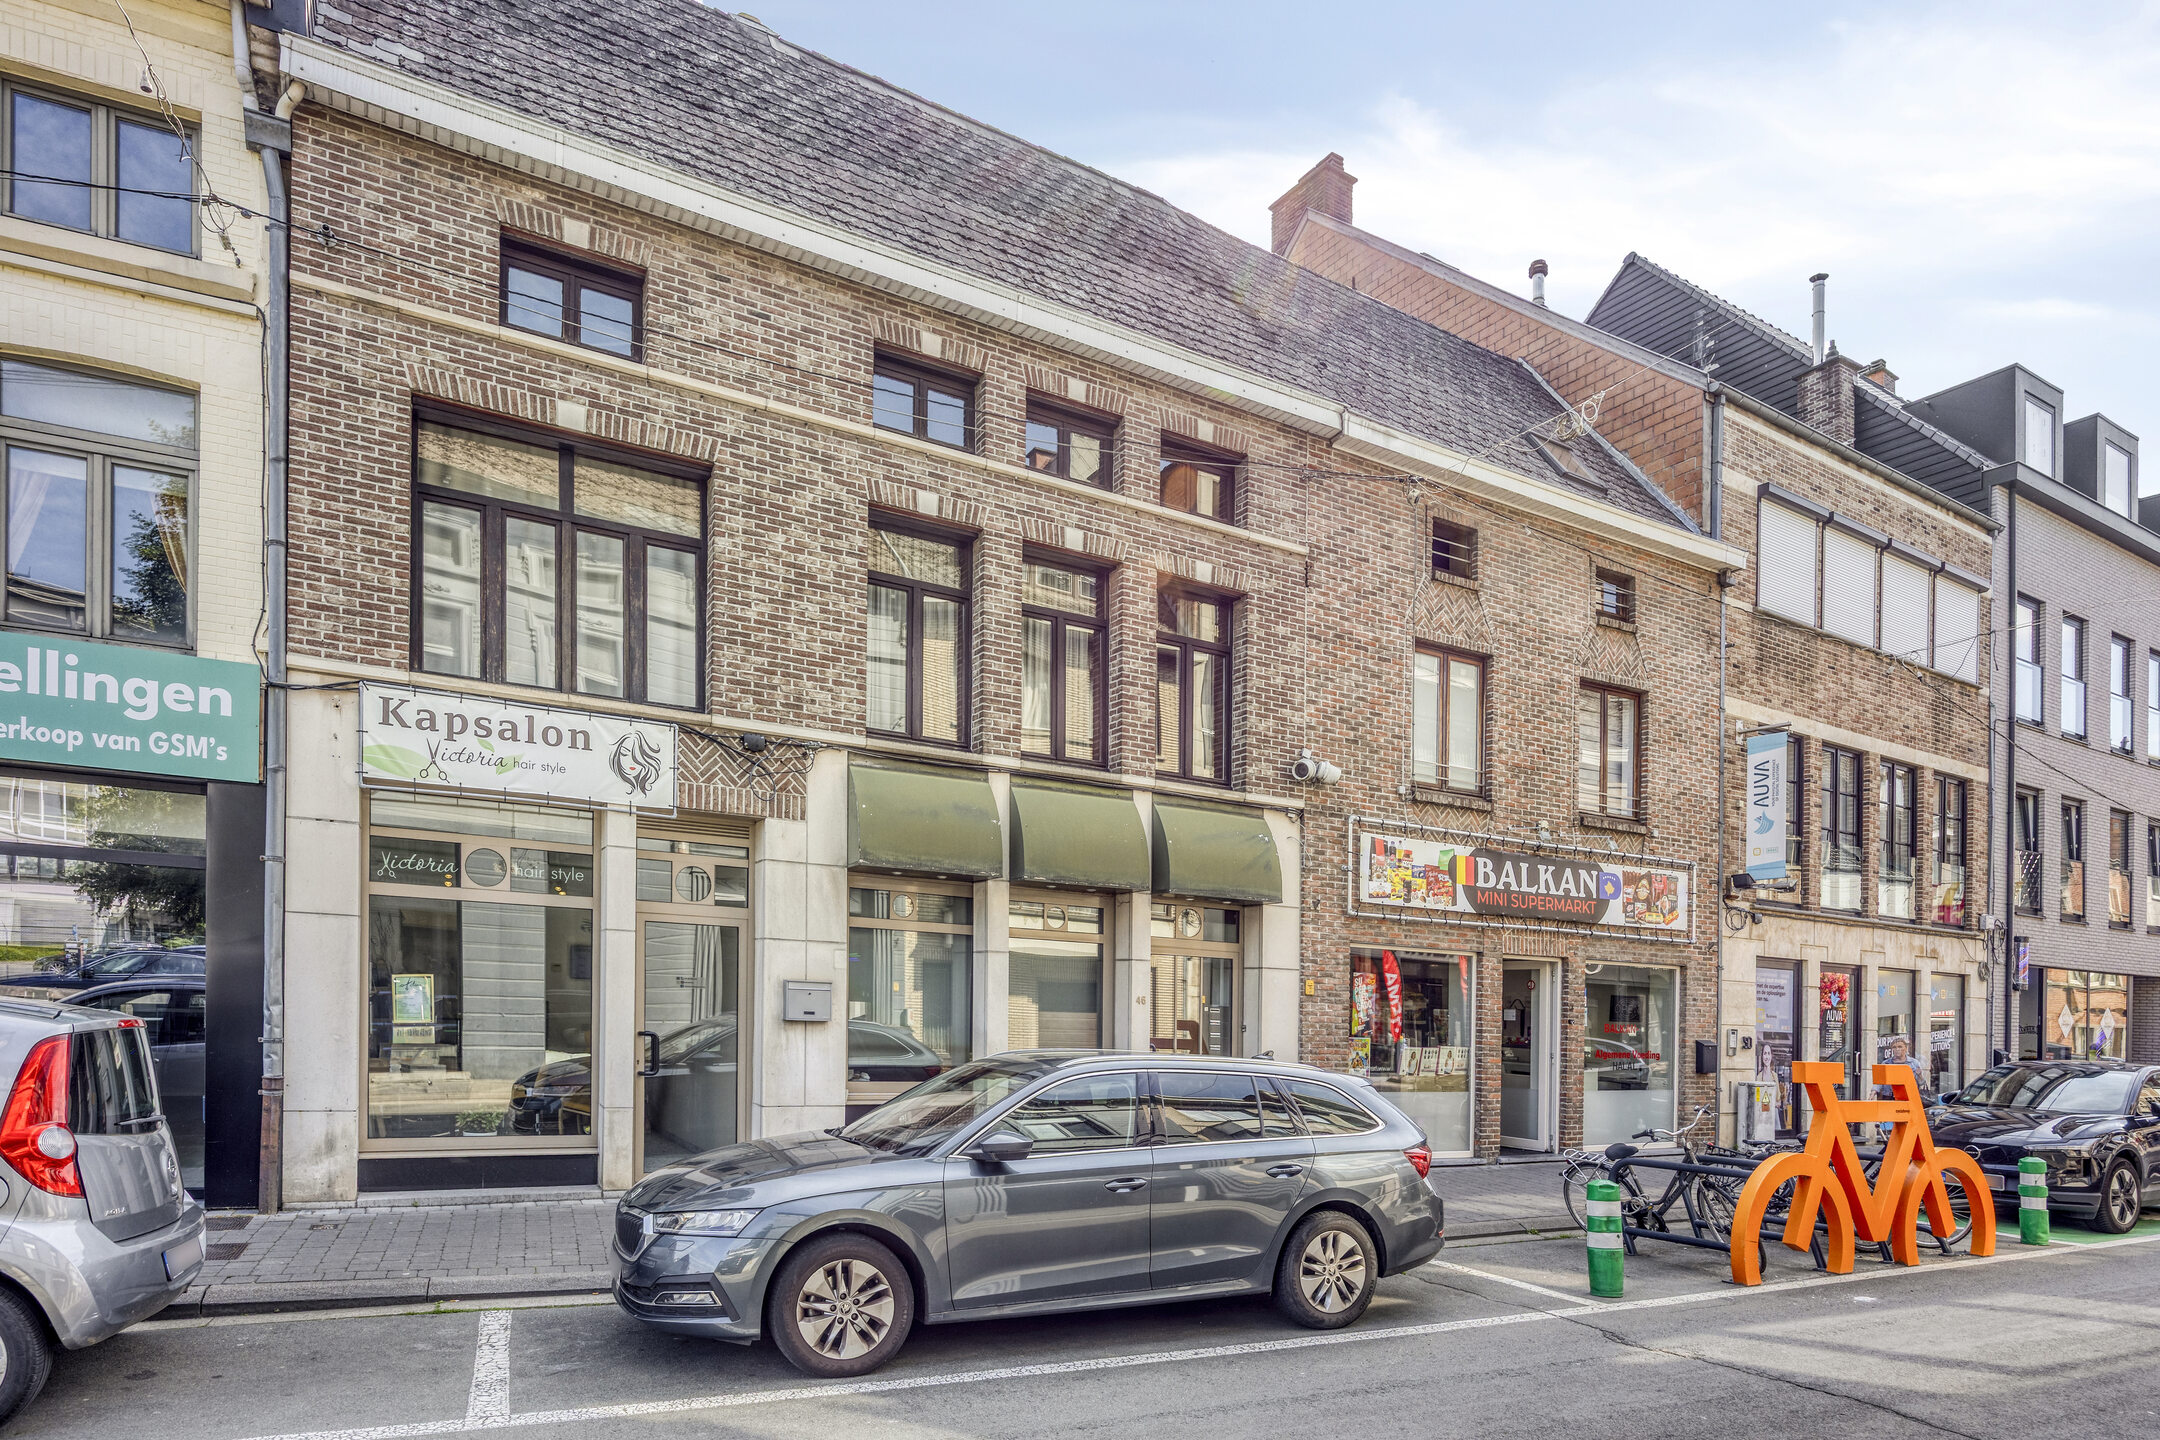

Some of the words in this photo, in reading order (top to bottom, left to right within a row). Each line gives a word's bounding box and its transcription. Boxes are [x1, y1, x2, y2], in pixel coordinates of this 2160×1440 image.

[378, 696, 593, 751] Kapsalon
[92, 732, 141, 752] van
[149, 731, 228, 761] GSM's
[513, 757, 536, 771] hair
[541, 762, 567, 775] style
[1753, 760, 1770, 808] AUVA
[377, 851, 459, 879] Victoria
[515, 863, 545, 879] hair
[551, 867, 585, 884] style
[1475, 857, 1598, 899] BALKAN
[1477, 890, 1507, 907] MINI
[1511, 894, 1597, 914] SUPERMARKT
[1136, 996, 1146, 1005] 46
[1826, 1010, 1843, 1021] AUVA
[1595, 1050, 1631, 1060] Algemene
[1632, 1050, 1660, 1060] Voeding
[1612, 1061, 1638, 1071] HALAL
